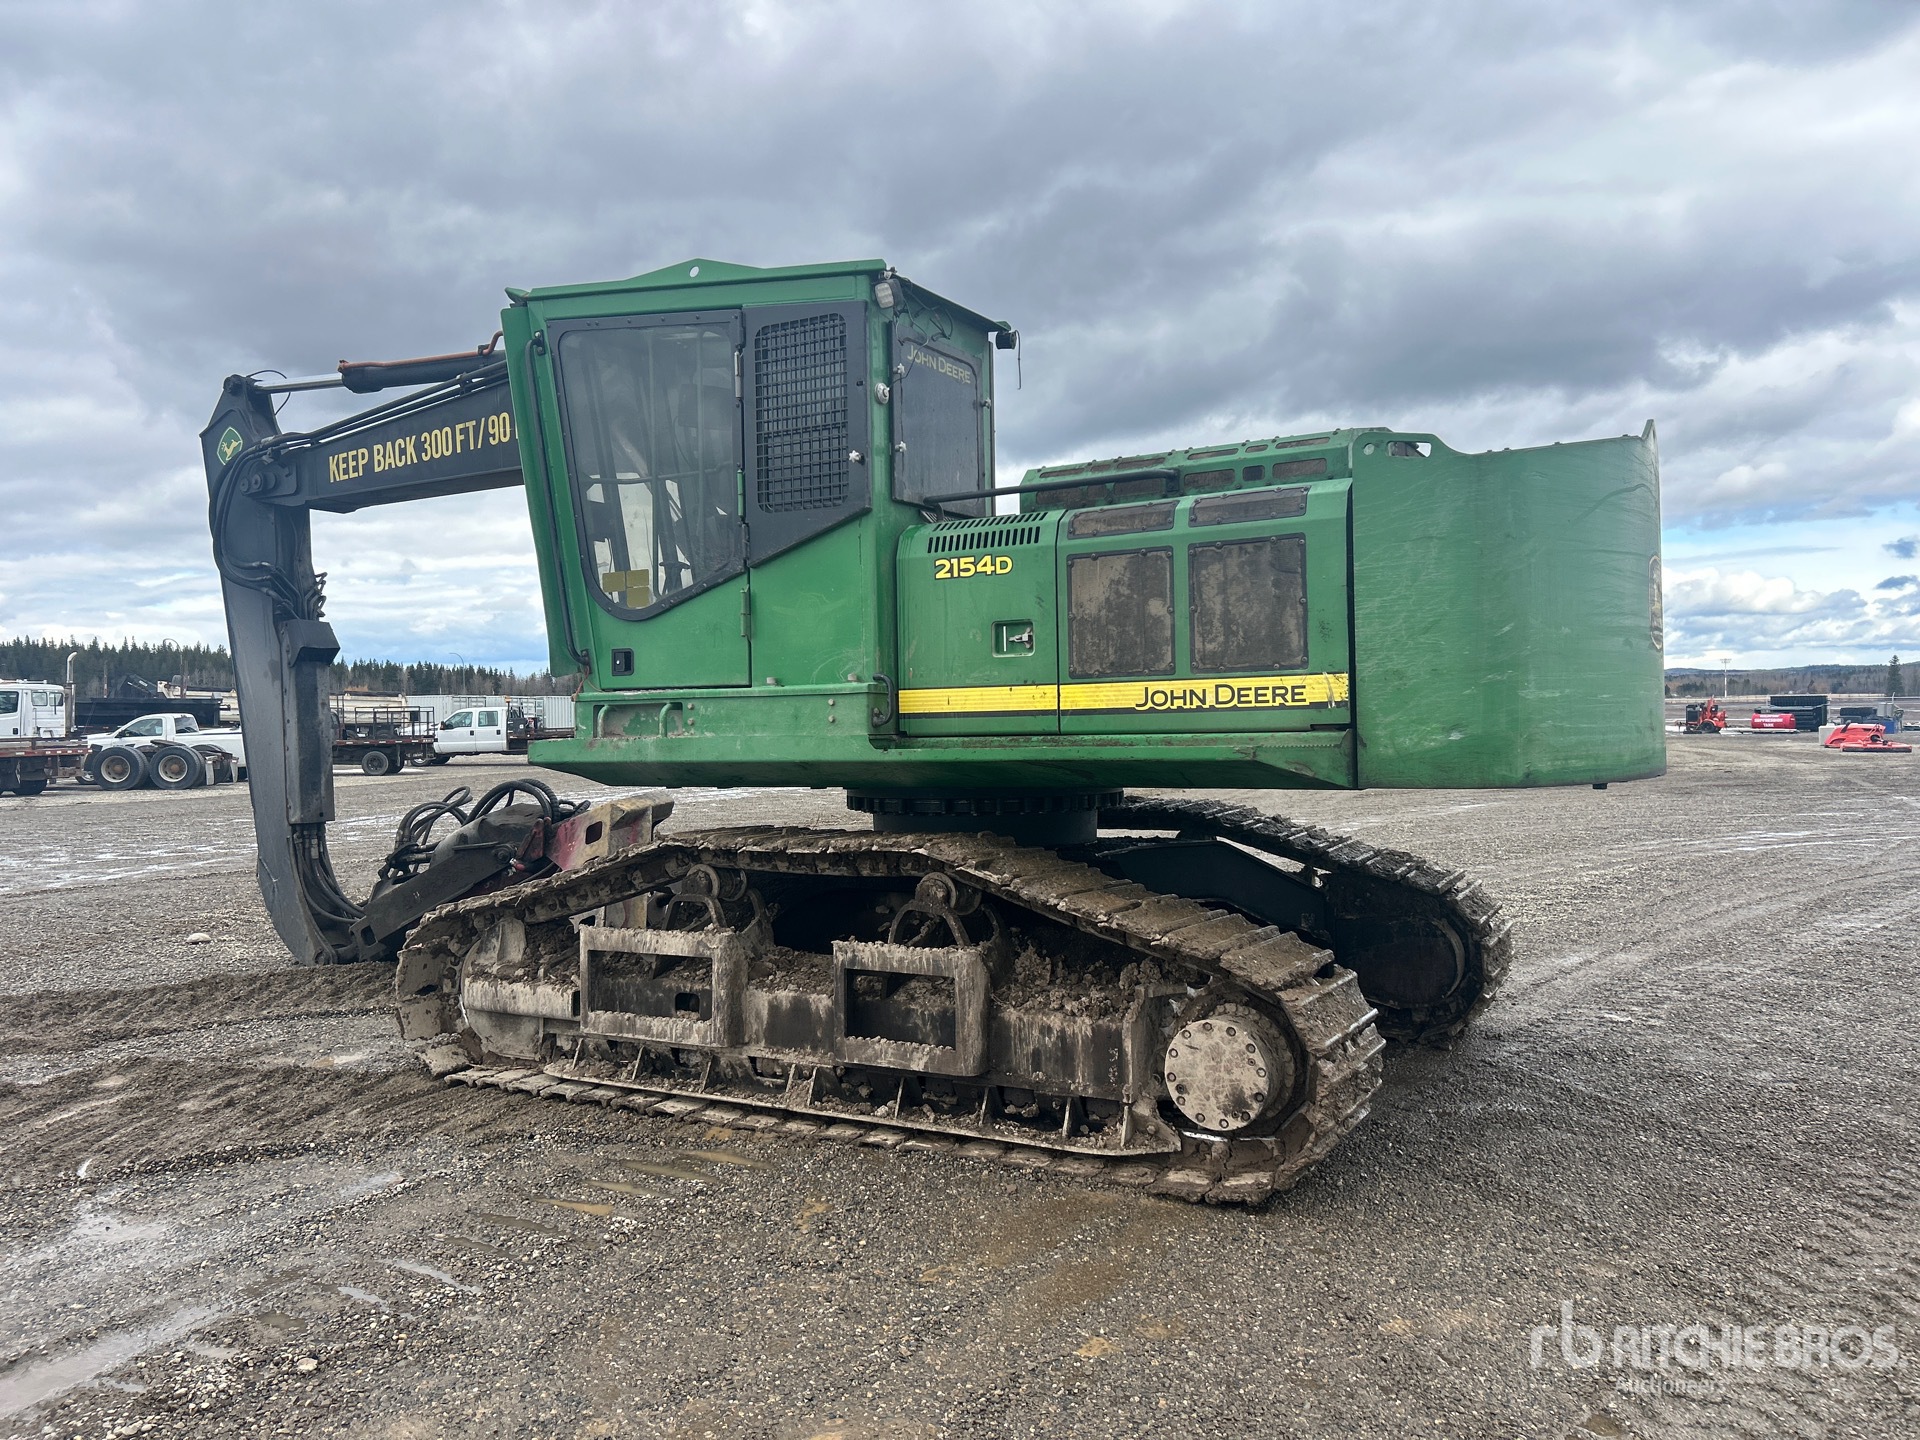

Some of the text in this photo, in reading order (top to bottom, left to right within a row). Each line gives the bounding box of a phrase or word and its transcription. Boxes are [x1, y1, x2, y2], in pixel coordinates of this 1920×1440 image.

[907, 345, 971, 384] JOHN DEERE
[329, 448, 369, 483] KEEP
[374, 435, 418, 473] BACK
[420, 427, 453, 462] 300
[934, 554, 1013, 580] 2154D
[1135, 684, 1307, 708] JOHN DEERE
